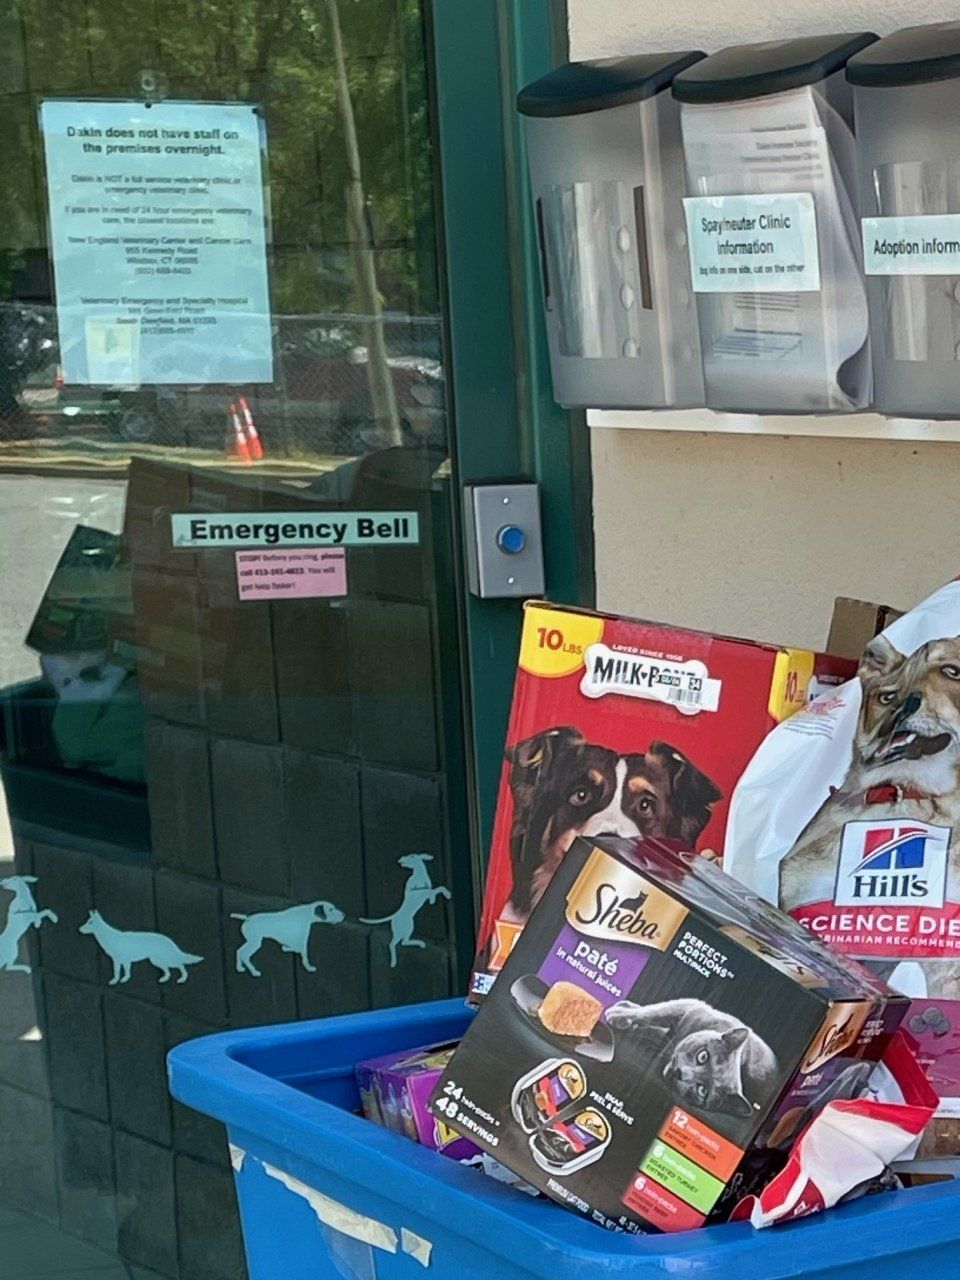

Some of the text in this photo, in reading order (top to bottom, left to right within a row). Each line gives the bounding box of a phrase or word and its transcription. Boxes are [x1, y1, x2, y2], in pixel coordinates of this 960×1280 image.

[105, 128, 135, 139] does
[138, 128, 159, 139] not
[161, 128, 190, 139] have
[194, 128, 221, 139] staff
[223, 131, 239, 140] on
[82, 143, 225, 156] the premises overnight.
[758, 213, 791, 230] Clinic
[717, 238, 774, 255] information
[873, 238, 919, 258] Adoption
[190, 518, 409, 543] Emergency Bell
[537, 627, 582, 655] 10 LBS
[784, 672, 797, 703] 10
[852, 874, 929, 898] Hill's
[575, 883, 659, 940] Sheba
[799, 914, 910, 933] SCIENCE
[683, 931, 728, 964] PERFECT
[818, 934, 883, 945] RINARIAN
[573, 940, 619, 976] paté
[556, 947, 622, 997] in natural juices
[443, 1080, 464, 1100] 24
[435, 1097, 499, 1147] 48 SERVINGS
[672, 1111, 689, 1130] 12
[634, 1176, 647, 1191] 6
